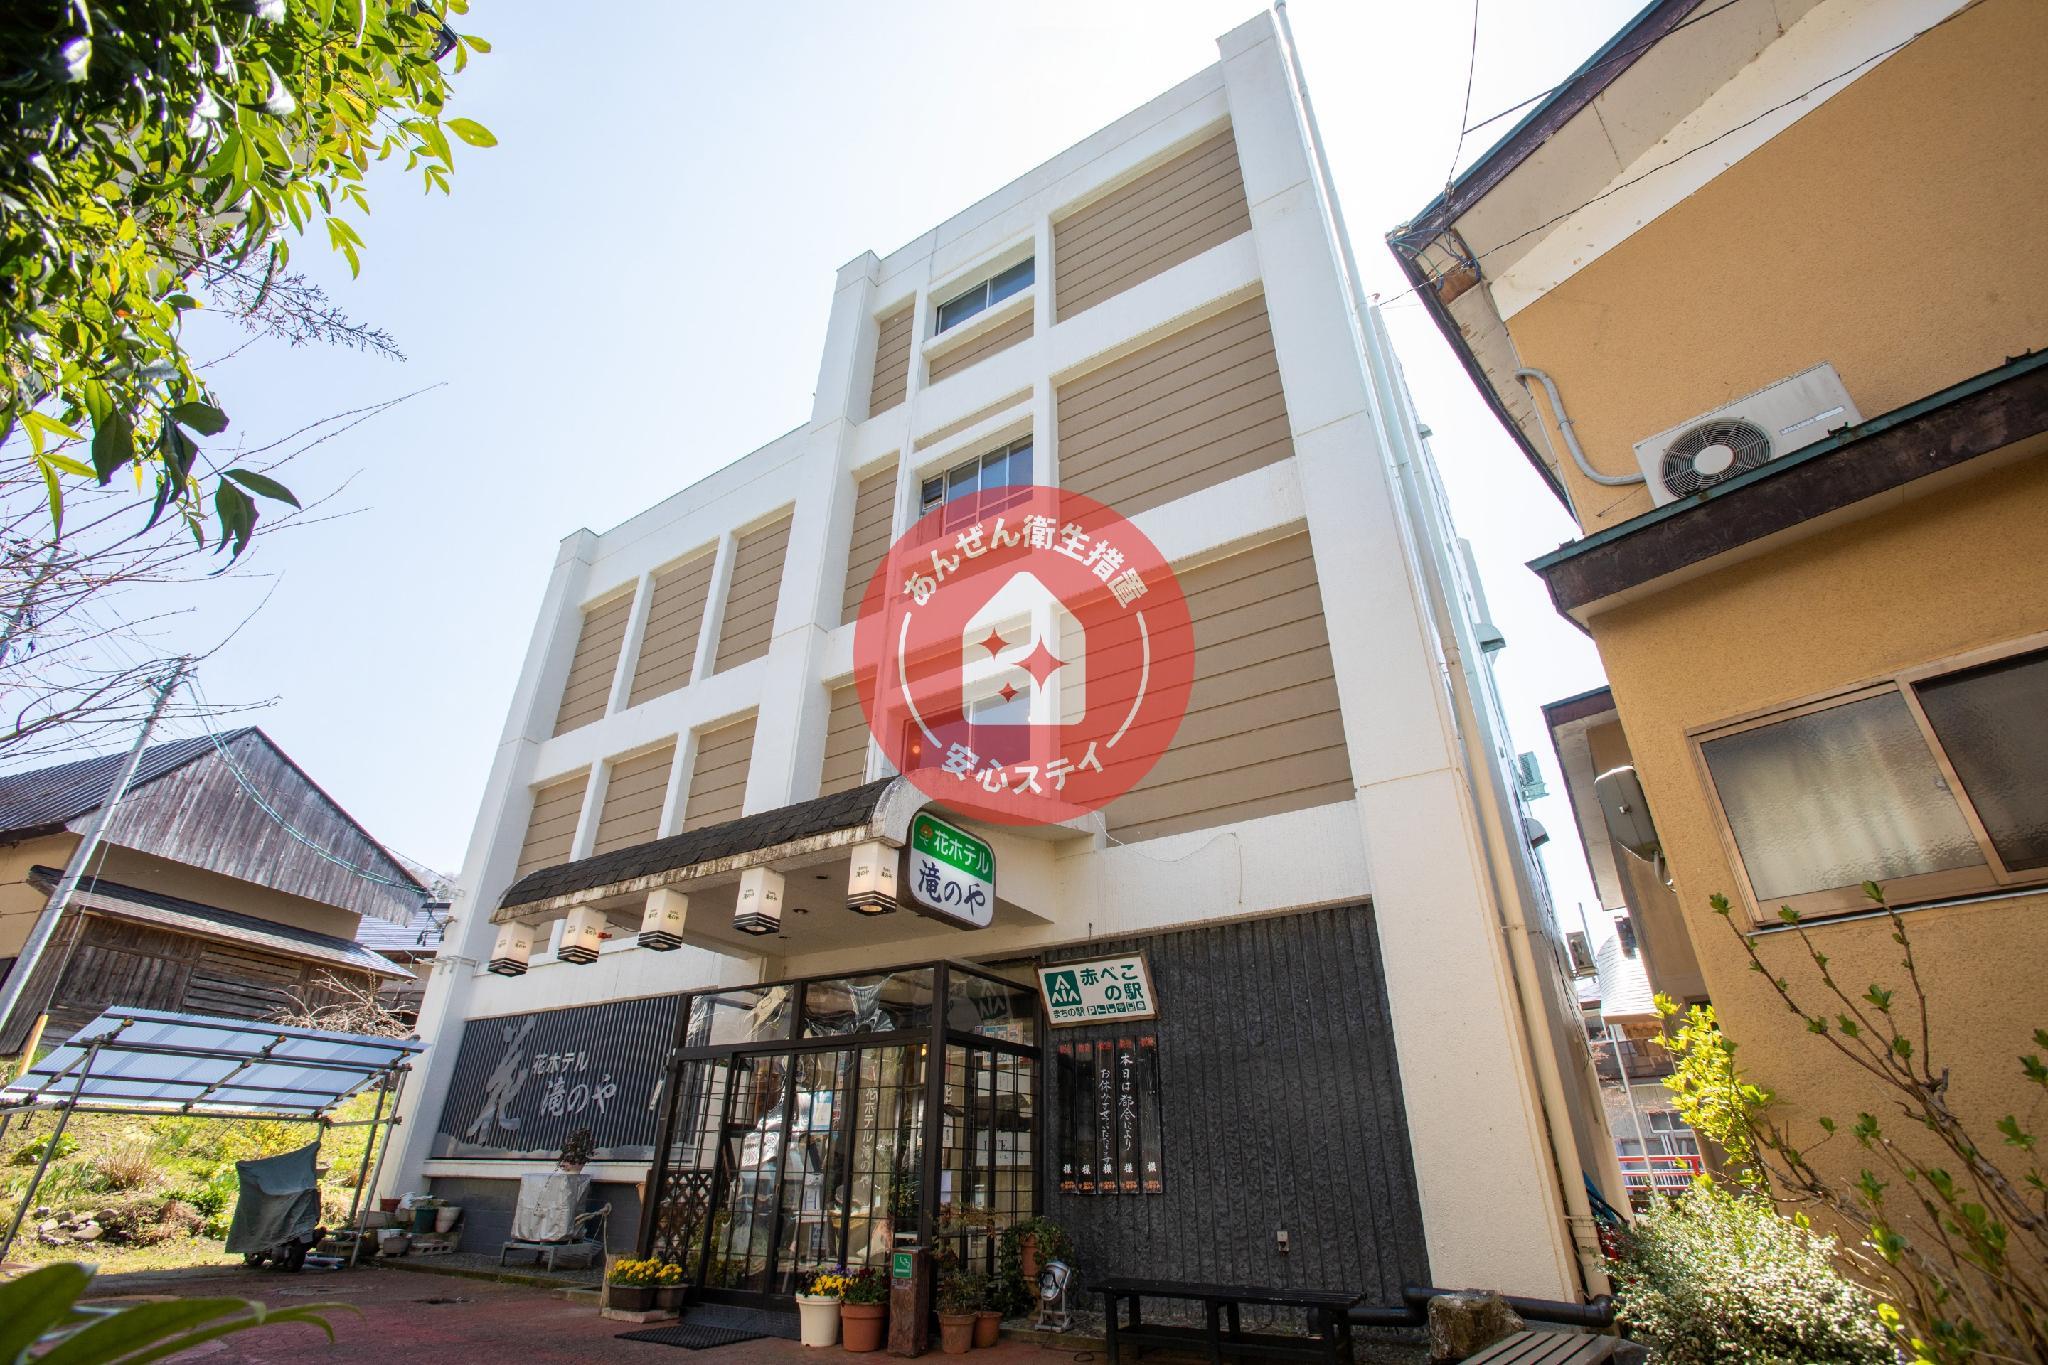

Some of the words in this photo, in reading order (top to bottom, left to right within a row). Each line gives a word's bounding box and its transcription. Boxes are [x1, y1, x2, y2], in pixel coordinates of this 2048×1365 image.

[933, 830, 990, 874] 花ホテル
[918, 859, 986, 917] 滝のや
[1080, 964, 1138, 986] 赤べこ
[1105, 982, 1143, 1001] の駅
[1052, 1007, 1085, 1019] まちの駅
[532, 1051, 590, 1075] 花ホテル
[540, 1073, 617, 1117] 滝のや
[1118, 1052, 1136, 1152] 本日は都合により
